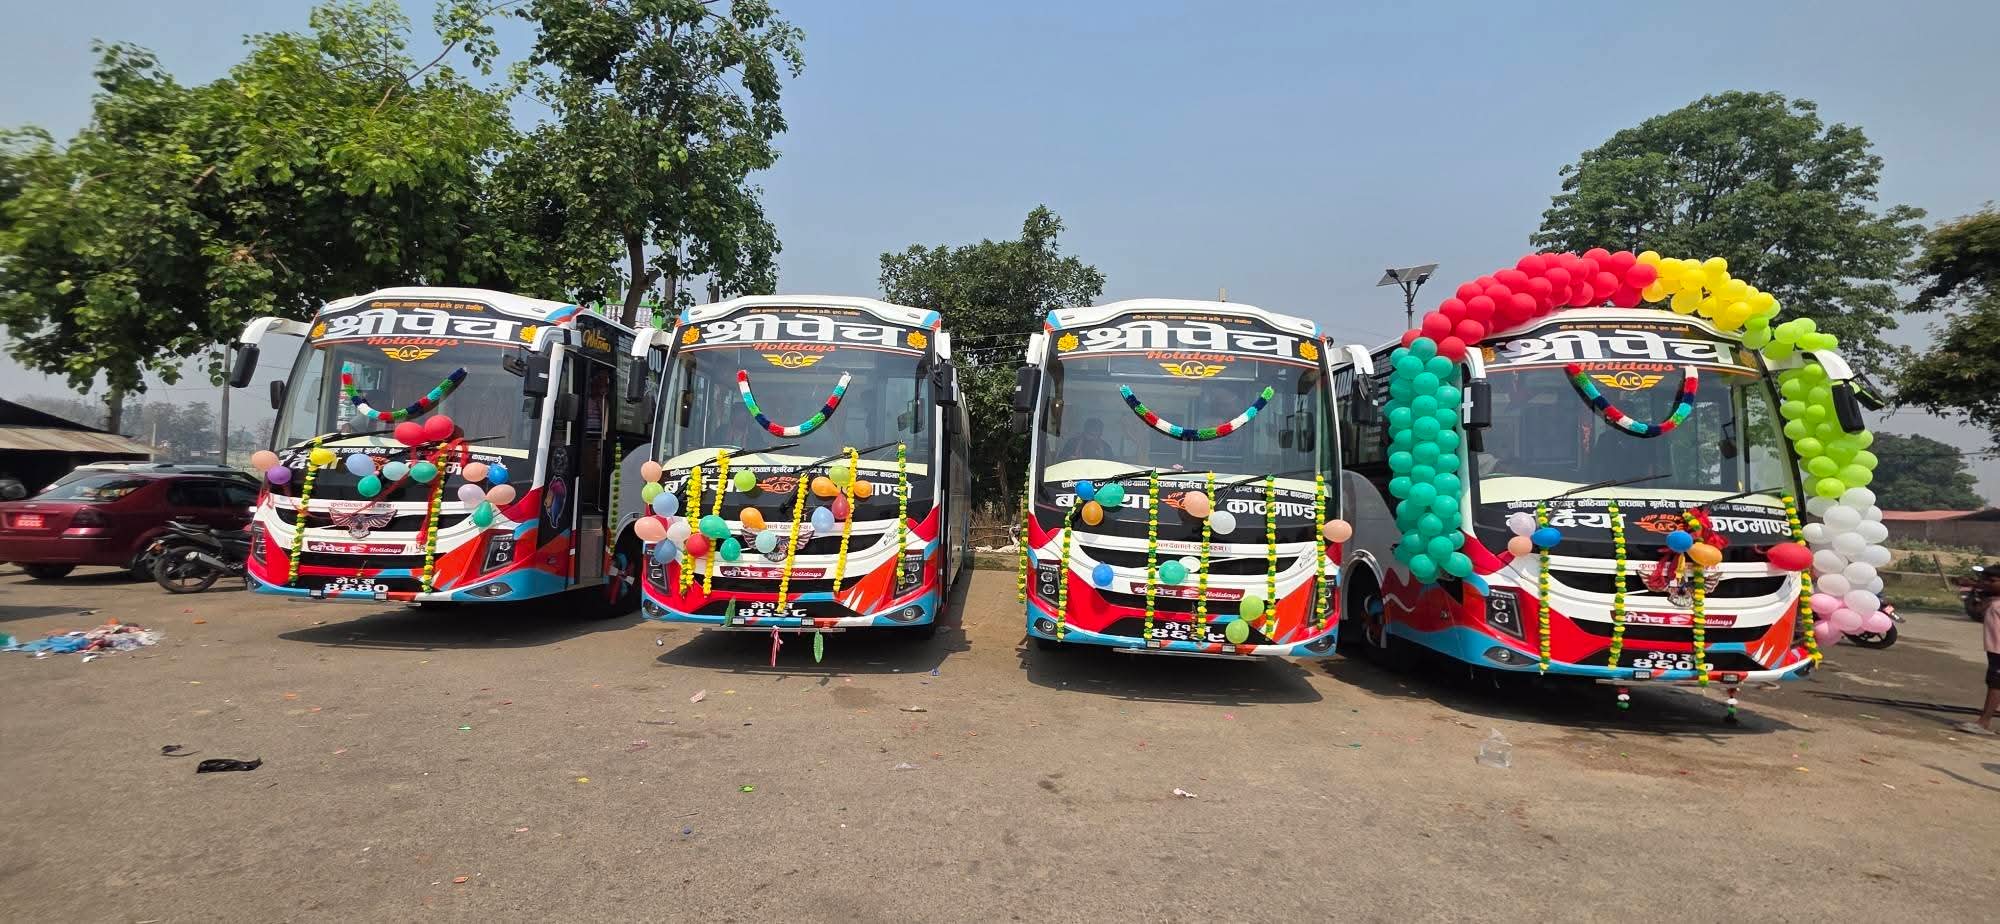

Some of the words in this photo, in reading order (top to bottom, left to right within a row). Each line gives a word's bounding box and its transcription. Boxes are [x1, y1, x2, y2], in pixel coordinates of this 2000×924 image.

[326, 307, 522, 341] श्रीपेच
[700, 314, 906, 347] श्रीपेच
[367, 335, 459, 346] Holidays
[1080, 320, 1298, 357] श्रीपेच
[752, 342, 836, 352] Holidays
[1497, 329, 1735, 364] श्रीपेच
[1145, 350, 1236, 361] Holidays
[1579, 361, 1676, 372] Holidays
[1205, 591, 1241, 599] Holidays
